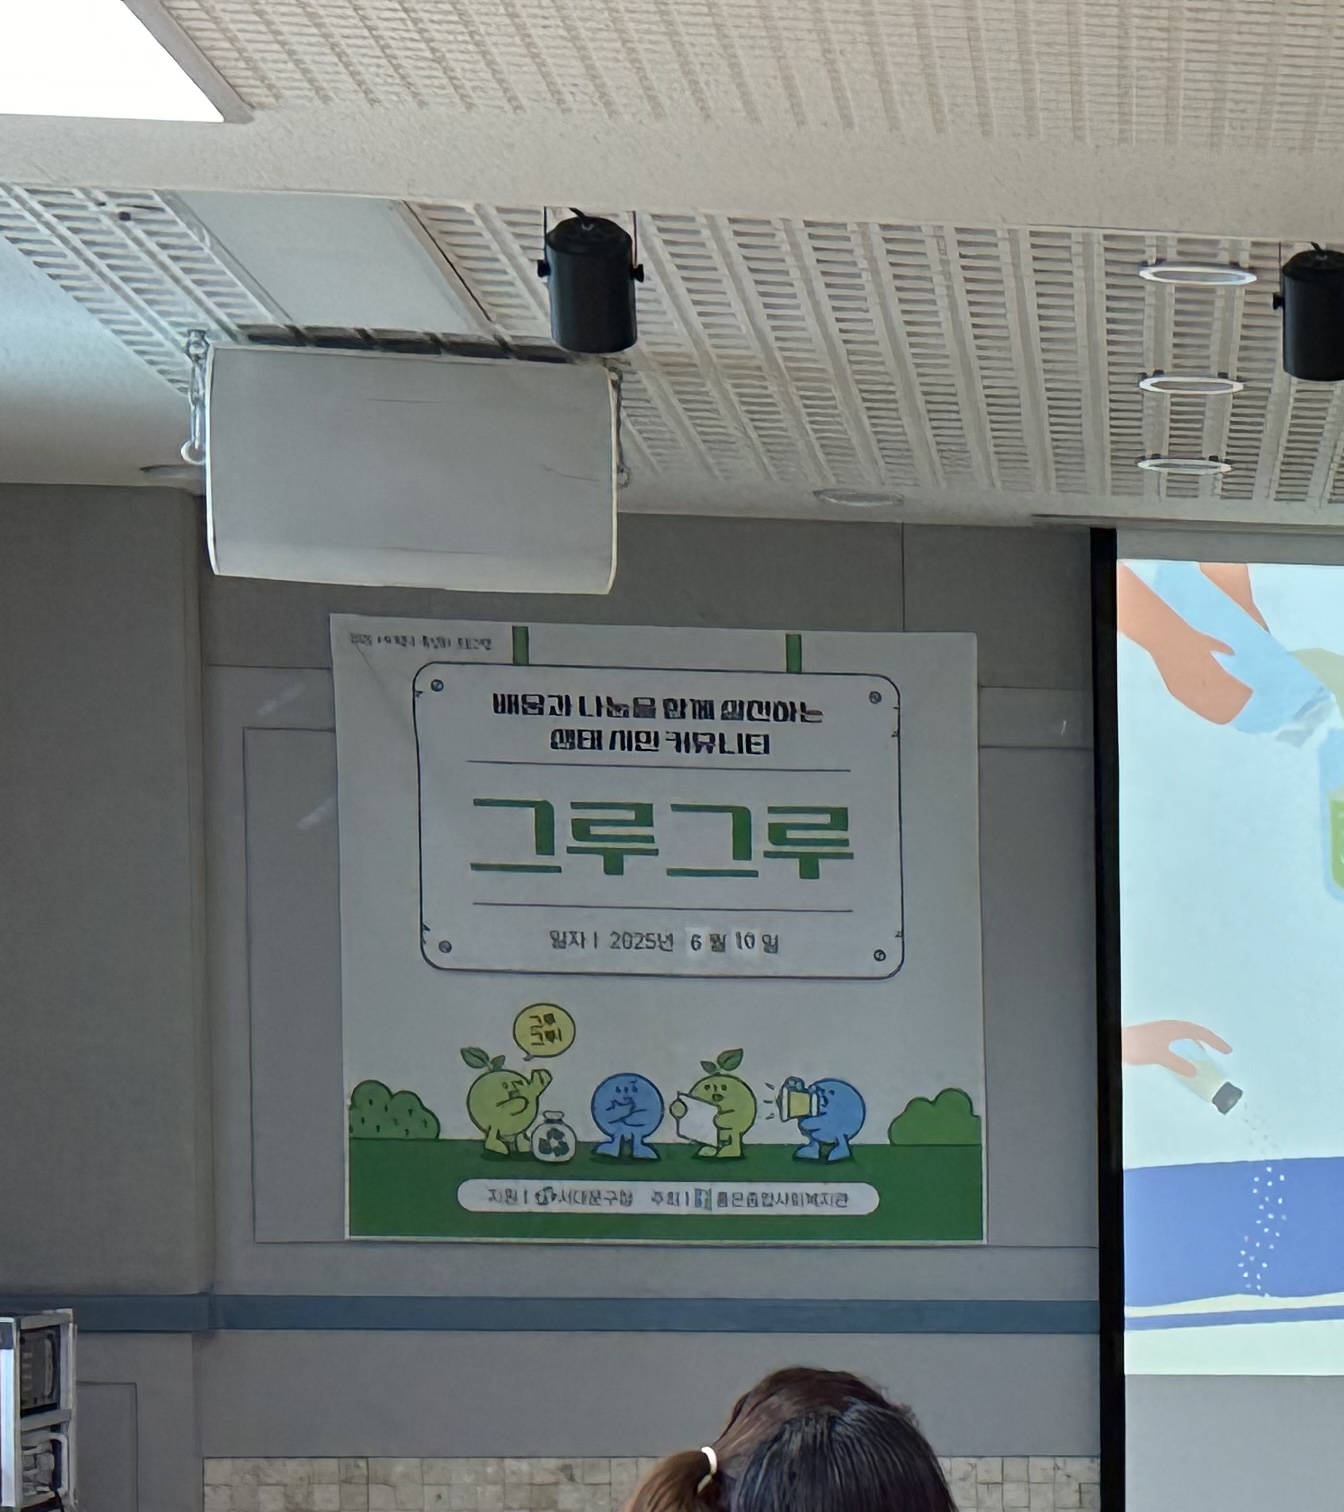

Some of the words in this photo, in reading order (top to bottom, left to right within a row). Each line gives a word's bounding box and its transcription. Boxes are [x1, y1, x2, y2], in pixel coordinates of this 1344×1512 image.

[609, 729, 660, 752] 시민
[664, 731, 771, 755] 커뮤니티
[470, 798, 854, 879] 그루그루
[610, 930, 674, 952] 2025년
[690, 934, 703, 951] 6
[735, 931, 756, 950] 10
